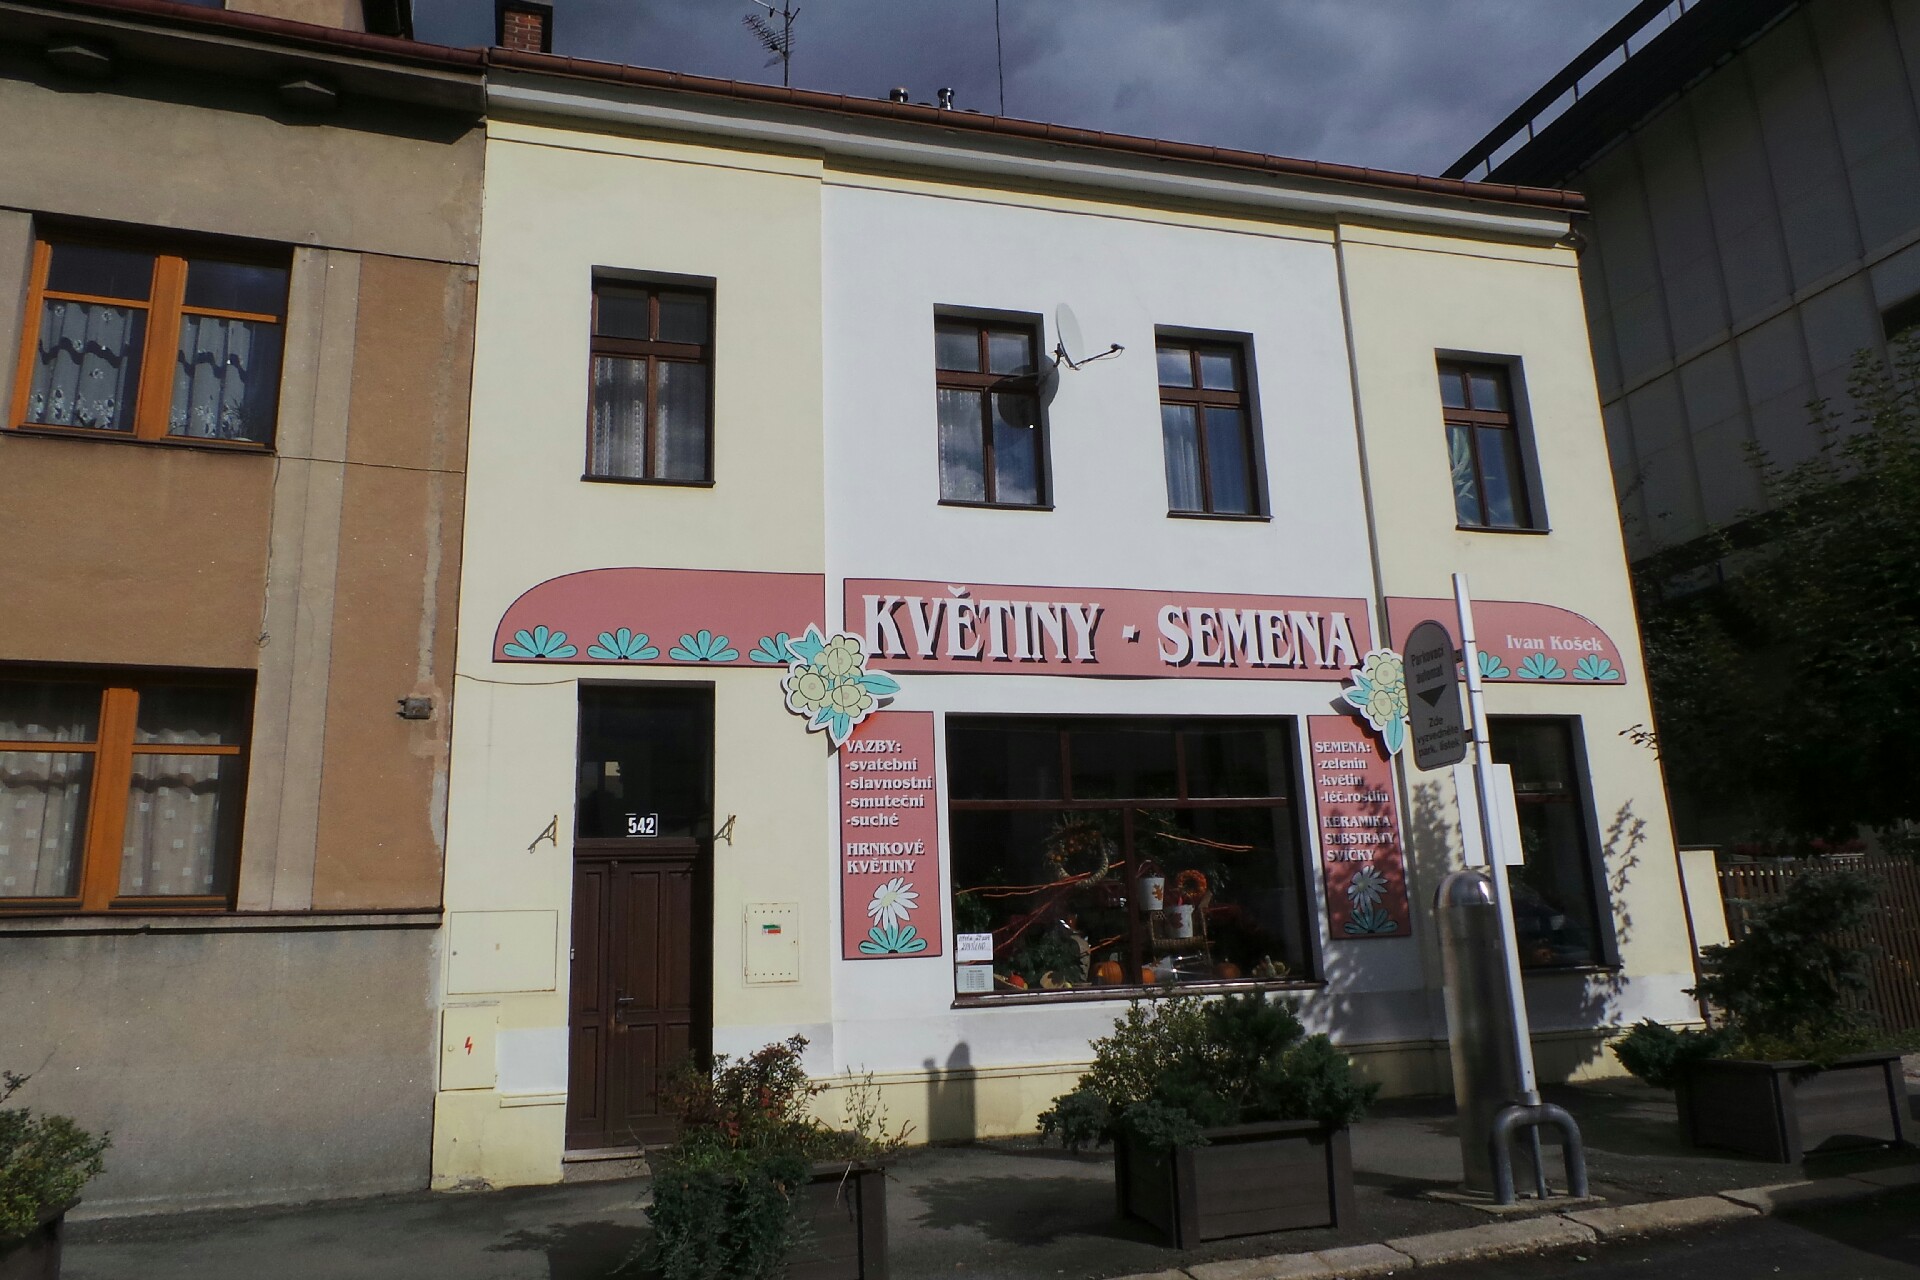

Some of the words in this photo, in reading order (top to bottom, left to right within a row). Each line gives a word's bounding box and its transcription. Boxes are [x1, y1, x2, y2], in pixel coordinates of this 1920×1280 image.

[862, 585, 1102, 662] KVĚTINY
[1157, 604, 1360, 669] SEMENA
[1506, 634, 1544, 650] Ivan
[1550, 635, 1603, 651] Košek
[1429, 715, 1443, 728] Zde
[845, 740, 902, 753] VAZBY:
[1314, 741, 1372, 754] SEMENA:
[845, 757, 918, 772] -svatební
[845, 776, 933, 790] -slavnostní
[846, 794, 925, 809] -smuteční
[628, 816, 655, 834] 542
[846, 812, 899, 827] -suché
[1322, 815, 1392, 829] KERAMIKA
[846, 839, 925, 856] HRNKOVÉ
[1326, 848, 1376, 862] SVÍČKY
[847, 858, 916, 874] KVĚTINY
